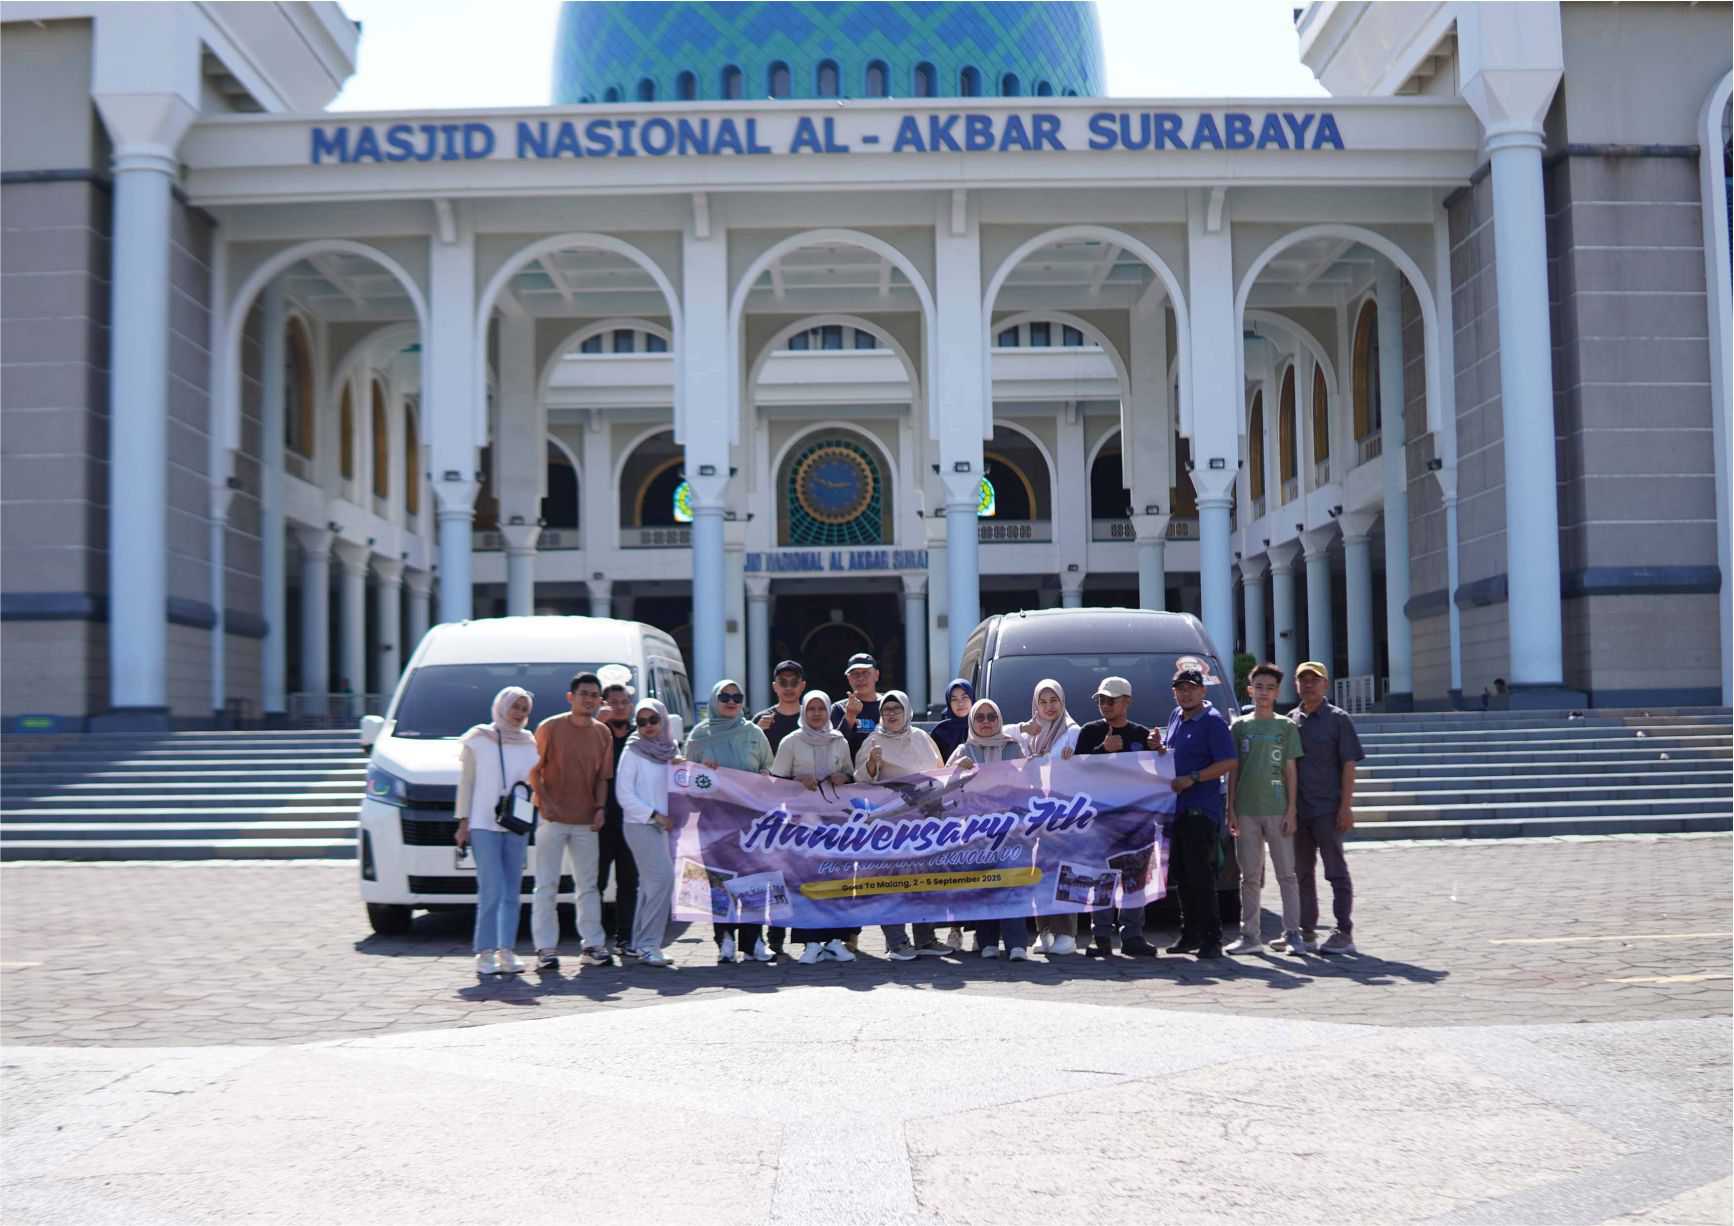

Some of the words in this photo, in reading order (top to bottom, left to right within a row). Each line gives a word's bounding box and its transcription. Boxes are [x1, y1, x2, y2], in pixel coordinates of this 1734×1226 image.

[311, 123, 495, 165] MASJID
[517, 118, 771, 159] NASIONAL
[789, 116, 849, 153] AL
[893, 114, 1067, 152] AKBAR
[1087, 112, 1346, 151] SURABAYA
[746, 809, 1014, 853] Anniversary
[1025, 796, 1092, 836] 7th
[877, 880, 912, 889] Malang,
[932, 877, 981, 887] September
